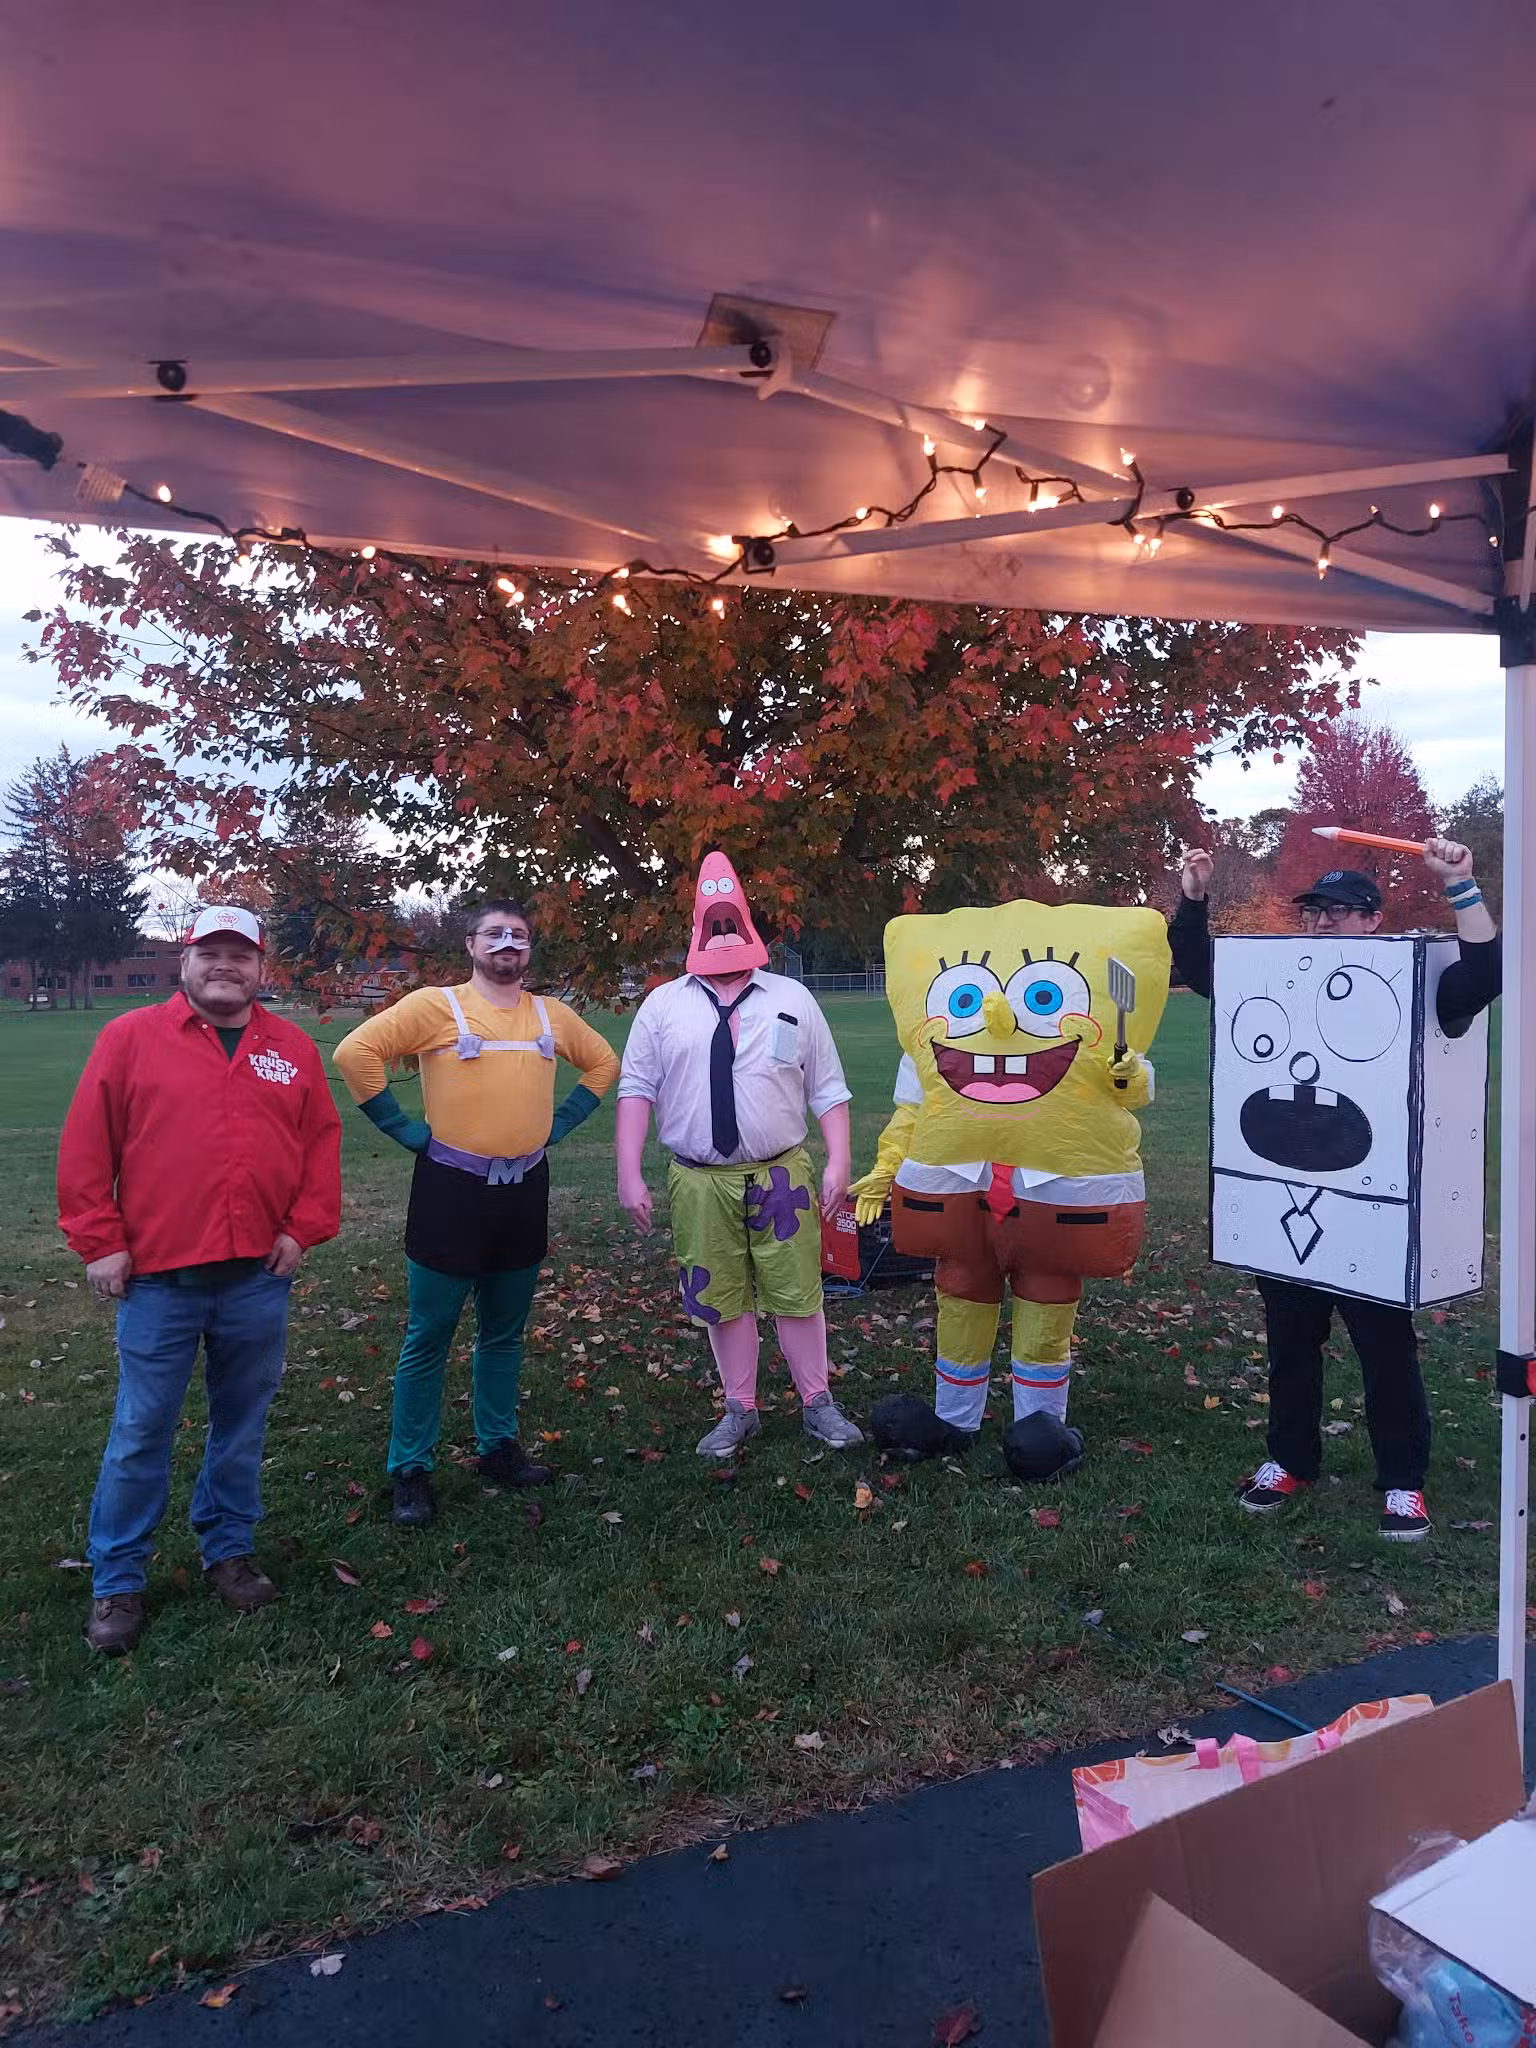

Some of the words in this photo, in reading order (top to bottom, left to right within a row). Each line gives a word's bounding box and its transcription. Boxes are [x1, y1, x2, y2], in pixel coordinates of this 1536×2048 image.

[266, 1048, 279, 1058] THE
[248, 1053, 298, 1078] KRUSTY
[487, 1158, 528, 1185] M
[836, 1217, 856, 1230] 3500
